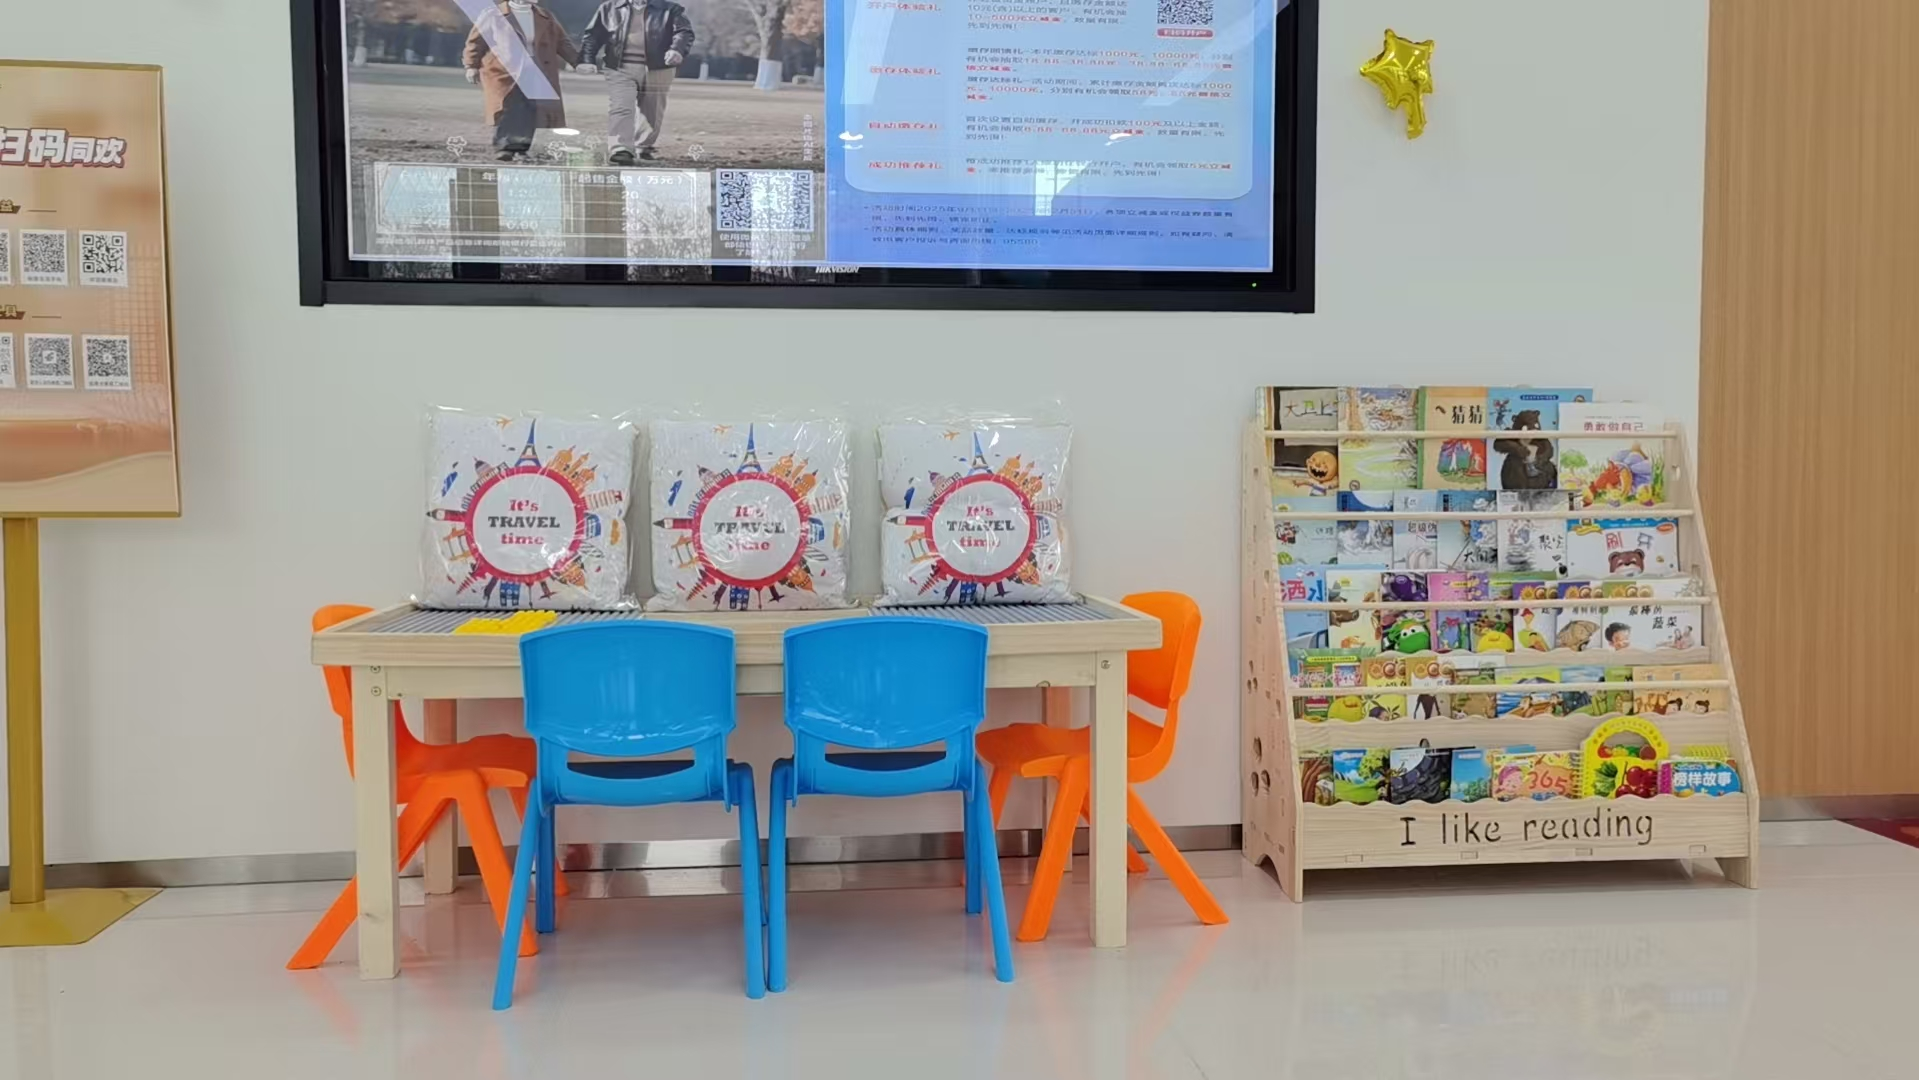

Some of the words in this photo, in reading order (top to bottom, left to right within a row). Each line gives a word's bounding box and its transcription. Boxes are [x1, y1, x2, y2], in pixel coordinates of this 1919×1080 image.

[1452, 405, 1482, 425] 猜猜
[1583, 421, 1644, 432] 勇敢做自己
[509, 499, 539, 512] It's
[966, 505, 994, 518] It's
[488, 516, 561, 529] TRAVEL
[946, 519, 1015, 532] TRAVEL
[501, 532, 545, 545] time
[1652, 615, 1678, 630] 蔬菜
[1527, 770, 1568, 795] 365
[1673, 770, 1733, 787] 榜样故事
[1399, 816, 1417, 846] I
[1441, 812, 1502, 845] like
[1522, 806, 1654, 846] reading
